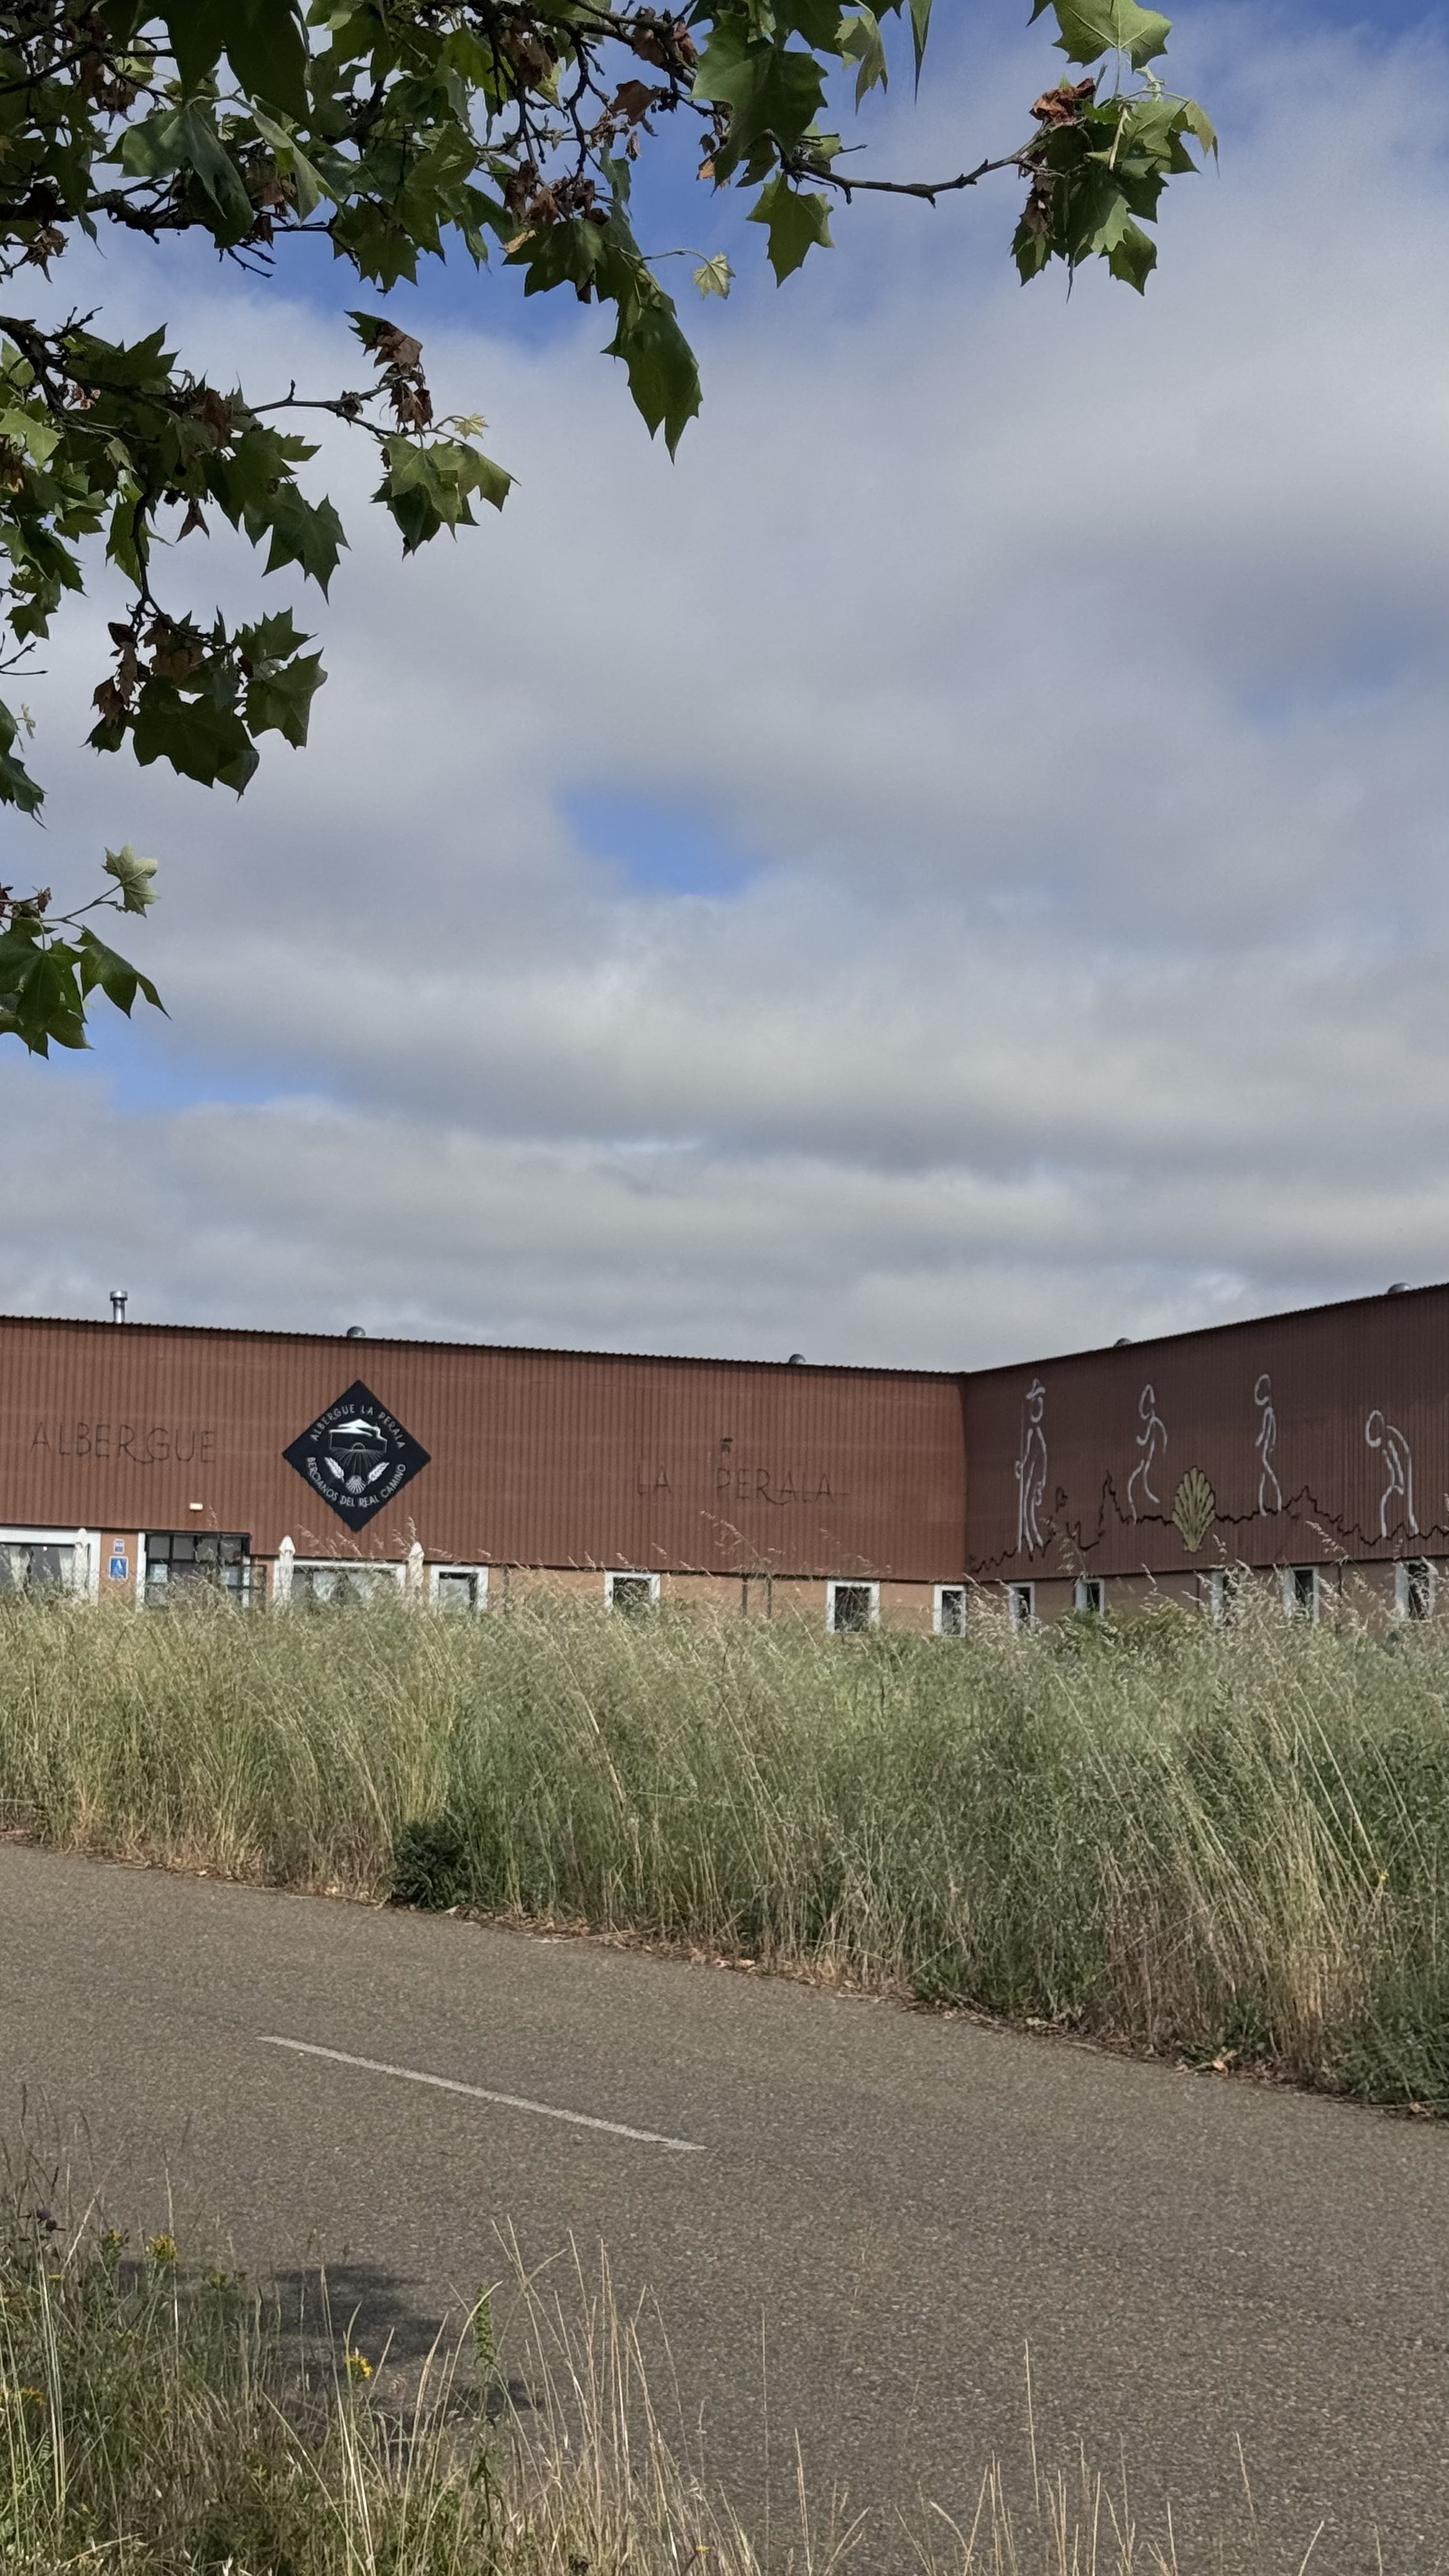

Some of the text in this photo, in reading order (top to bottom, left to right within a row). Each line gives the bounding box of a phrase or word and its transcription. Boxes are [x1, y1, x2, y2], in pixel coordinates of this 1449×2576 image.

[30, 1422, 216, 1464] ALBERGUE
[310, 1404, 406, 1450] ALBERGUE LA PERALA
[306, 1457, 406, 1508] BERCIANOS DEL REAL CAMINO
[637, 1465, 834, 1506] LA PERALA
